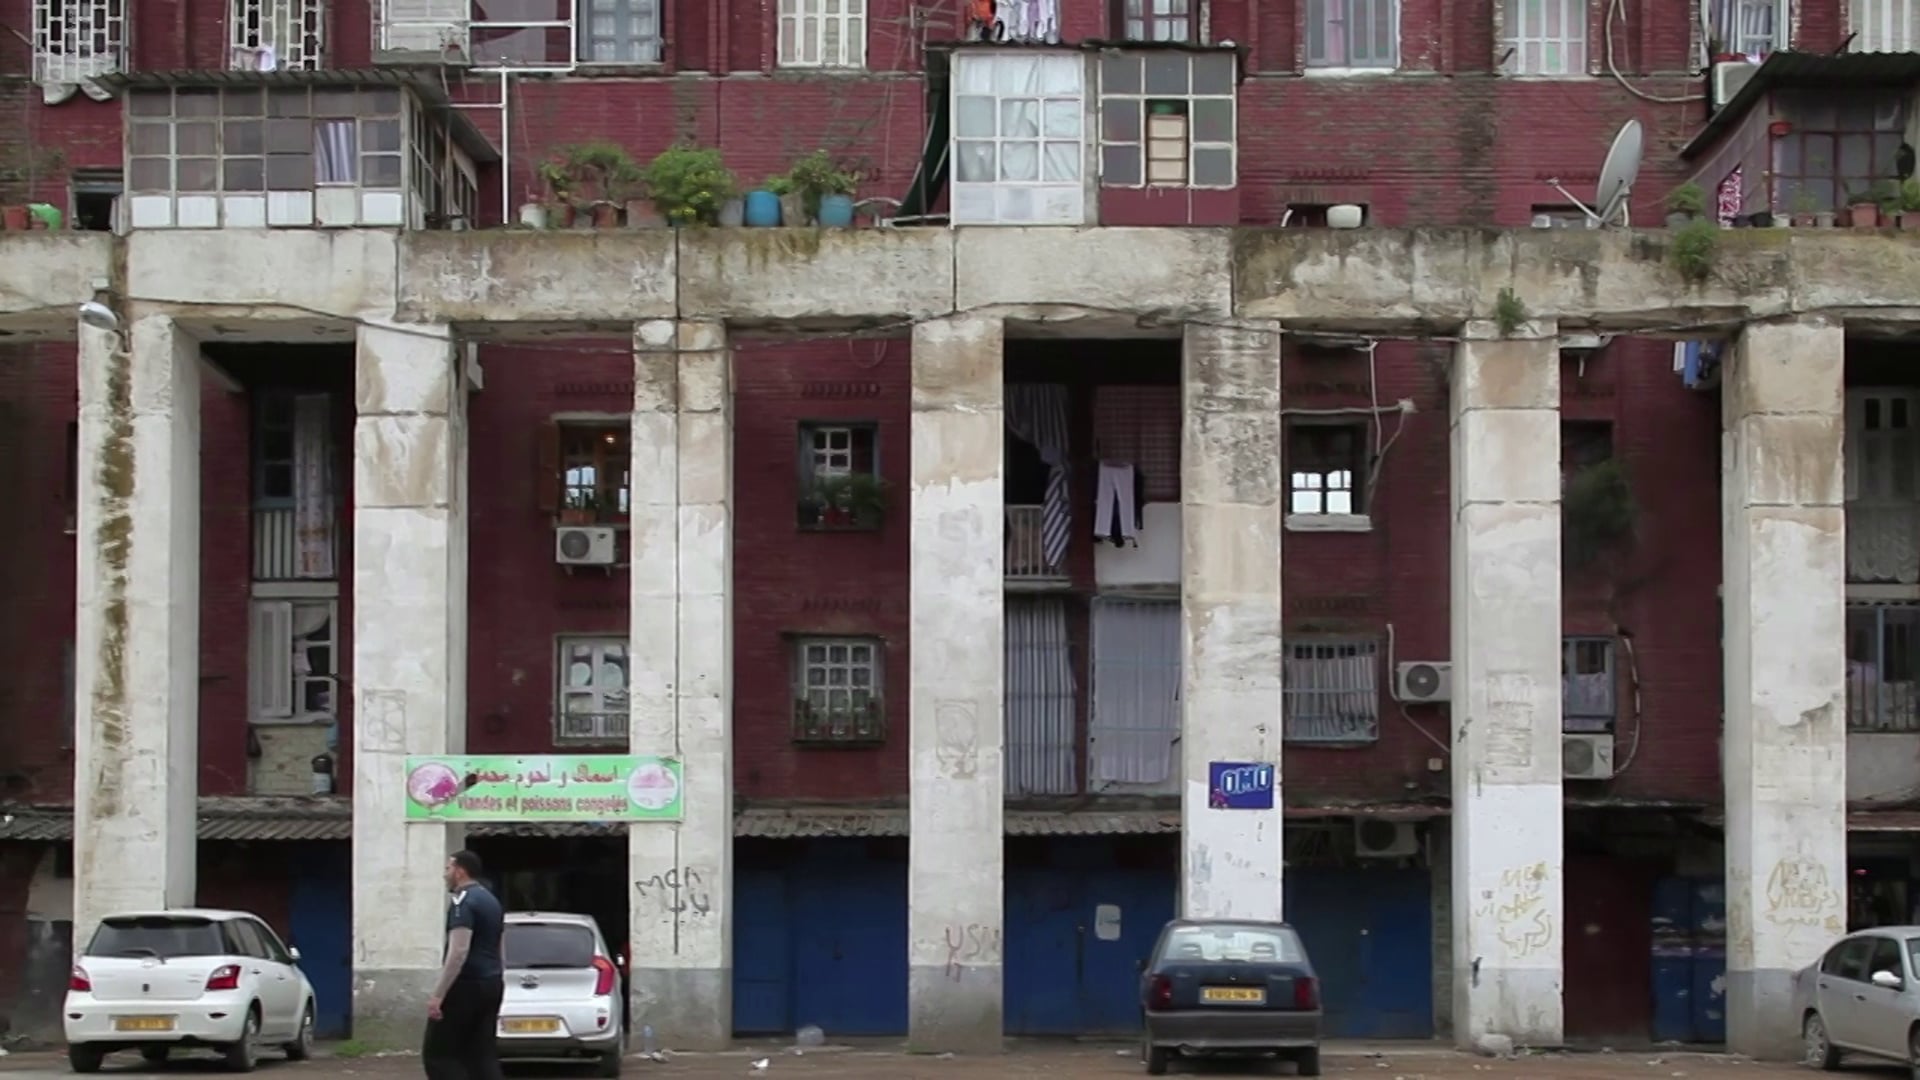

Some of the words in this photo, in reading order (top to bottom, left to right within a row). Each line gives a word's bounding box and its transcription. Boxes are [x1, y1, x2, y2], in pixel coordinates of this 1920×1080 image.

[1221, 765, 1271, 796] OMO
[506, 795, 518, 811] et
[521, 795, 572, 814] poissons
